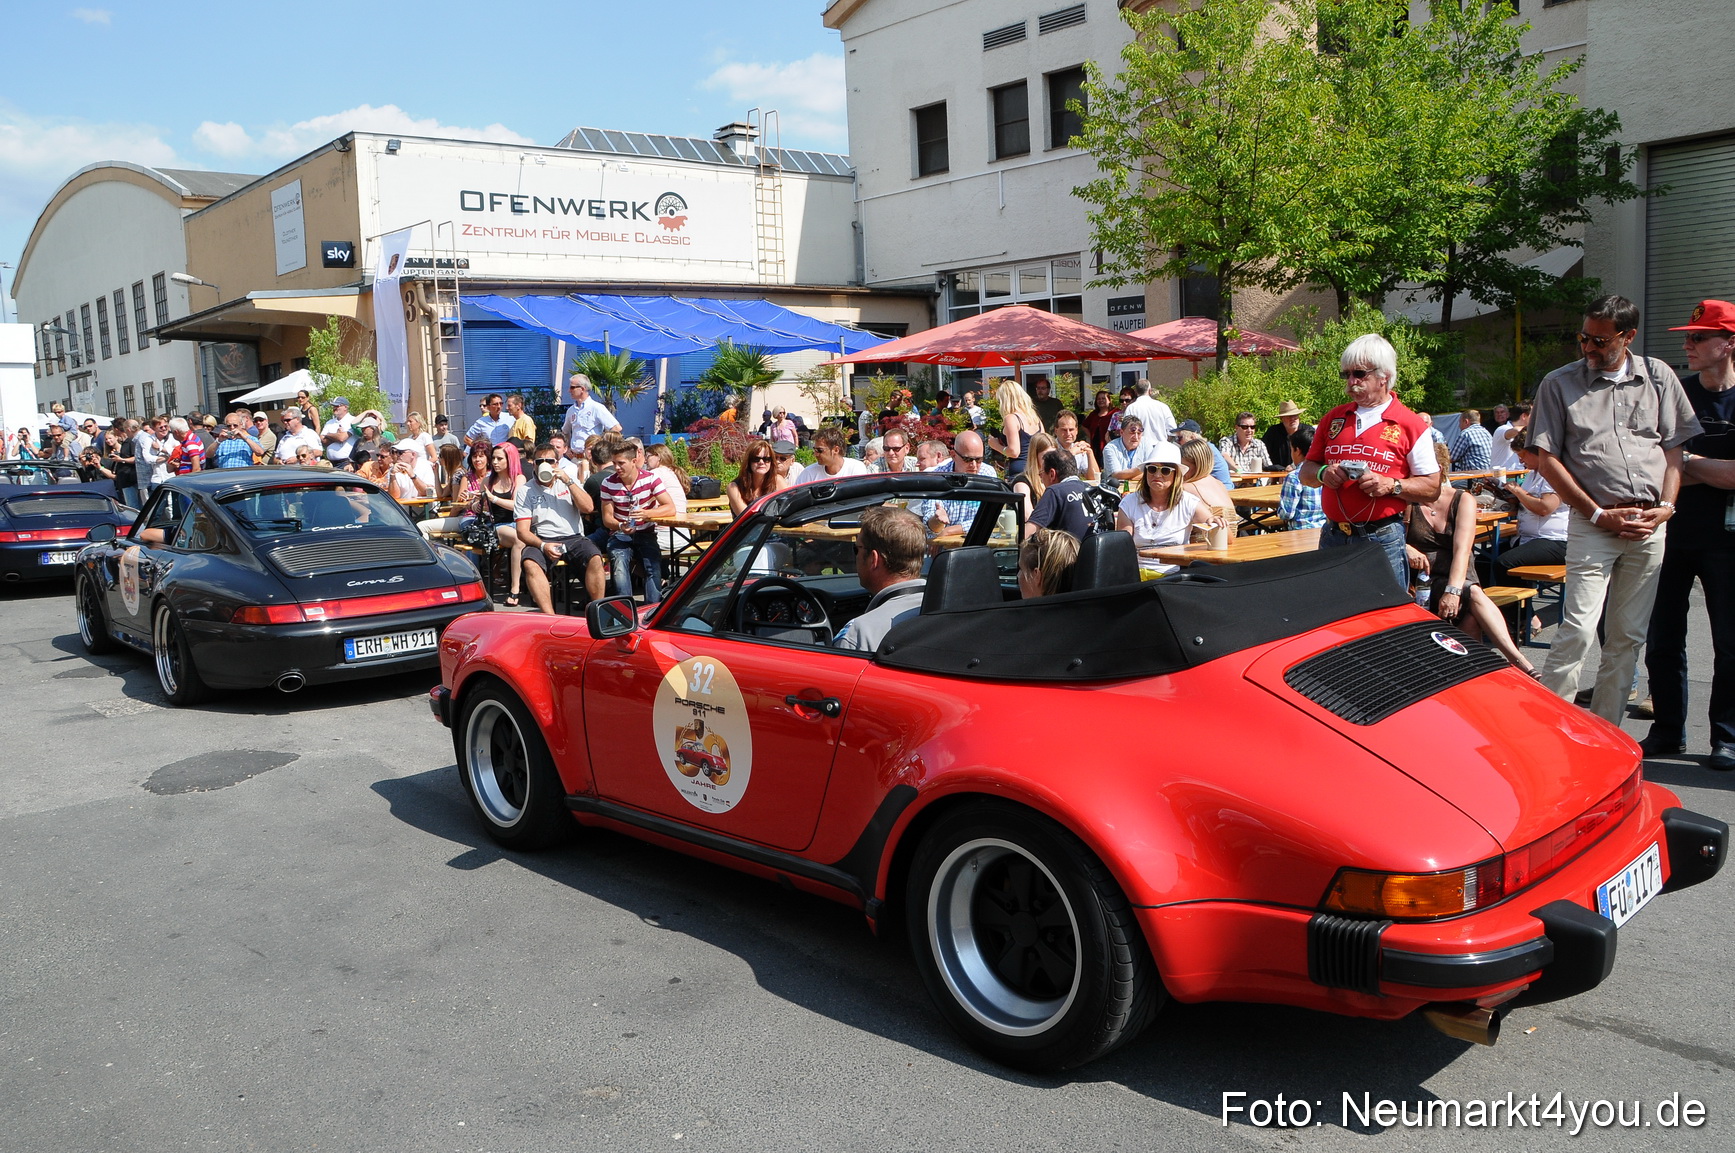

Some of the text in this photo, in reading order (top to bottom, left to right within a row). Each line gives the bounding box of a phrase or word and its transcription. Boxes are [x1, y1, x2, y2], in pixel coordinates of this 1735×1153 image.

[460, 190, 651, 222] OFENWERK
[462, 224, 691, 245] ZENTRUM FÜR MOBILE CLASSIC
[327, 246, 350, 262] sky
[405, 290, 417, 323] 3
[1325, 444, 1396, 463] PORSCHE
[355, 630, 435, 656] ERH WH 911
[690, 661, 715, 695] 32
[674, 697, 726, 715] PORSCHE
[692, 708, 706, 719] 911
[690, 779, 717, 791] JAHRE
